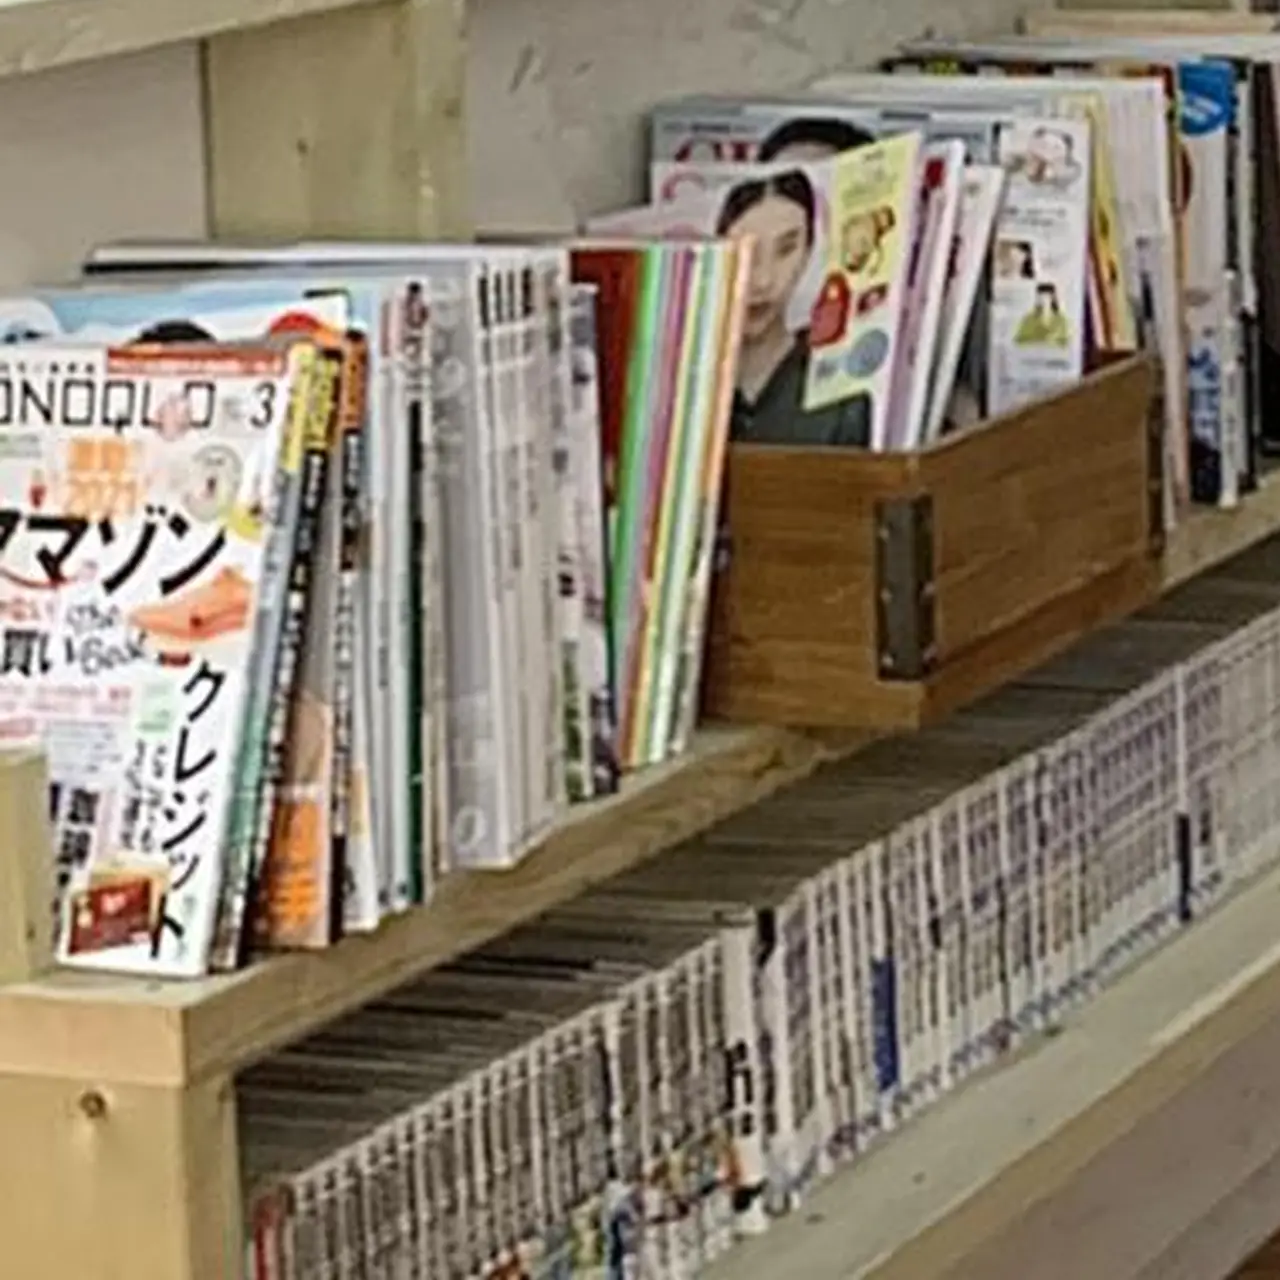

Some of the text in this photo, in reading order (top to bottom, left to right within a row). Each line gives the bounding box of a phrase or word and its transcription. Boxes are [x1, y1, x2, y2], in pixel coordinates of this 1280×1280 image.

[251, 381, 277, 428] 3
[151, 659, 227, 959] クレジット
